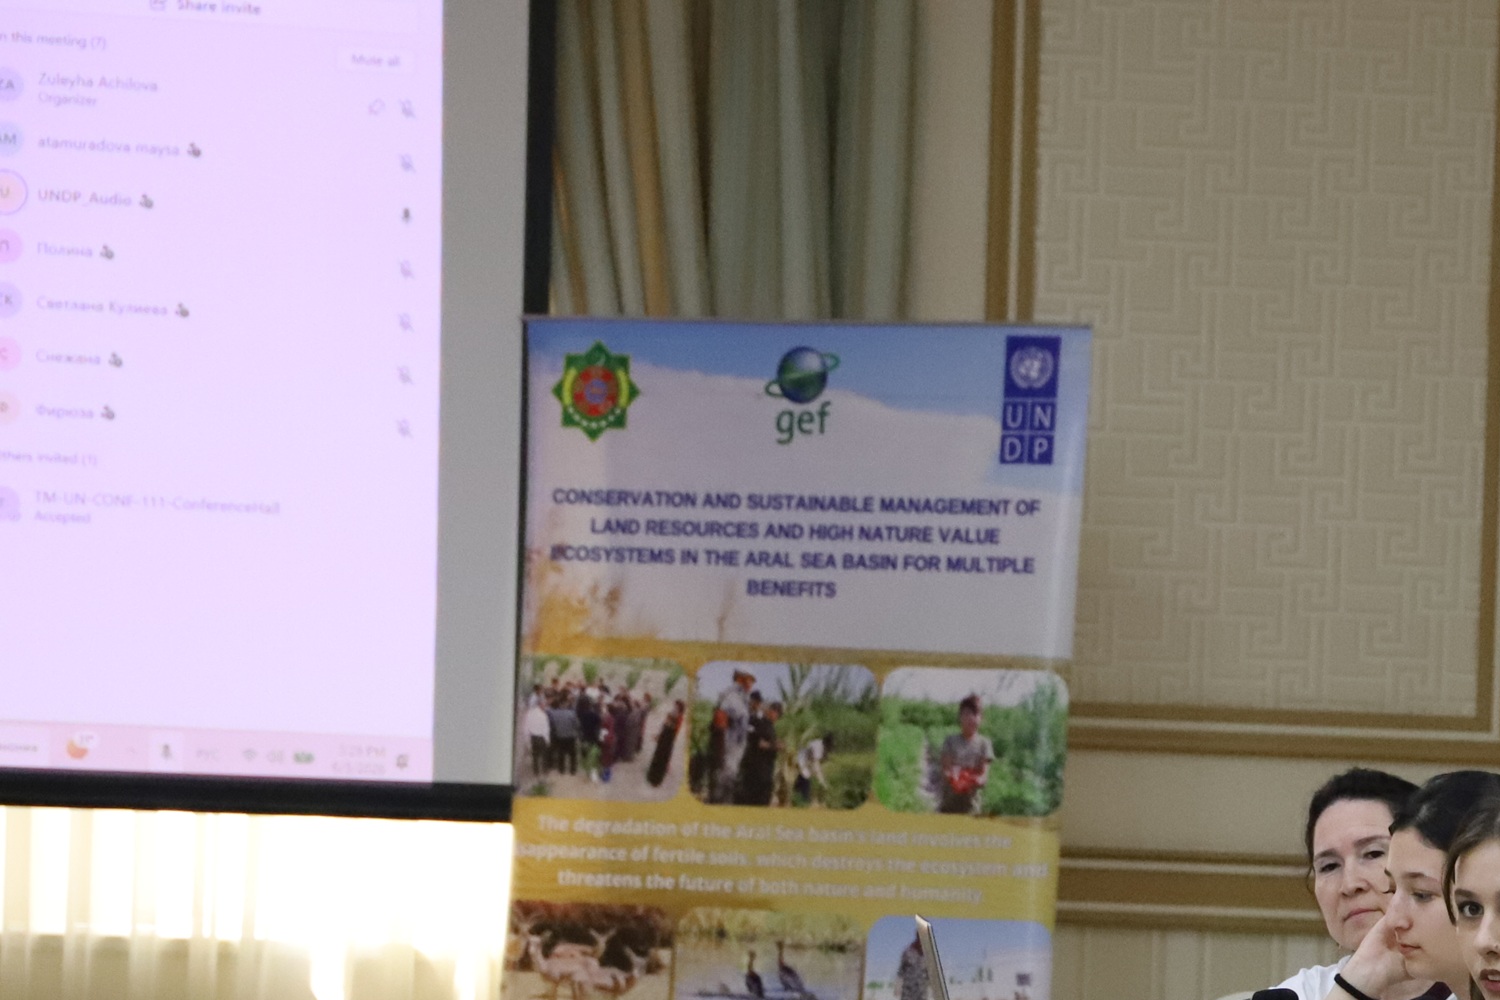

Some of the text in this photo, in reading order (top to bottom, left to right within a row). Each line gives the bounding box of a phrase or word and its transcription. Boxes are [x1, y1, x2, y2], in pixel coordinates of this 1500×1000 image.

[11, 31, 33, 44] this
[36, 33, 87, 49] meeting
[774, 401, 832, 446] gef
[552, 487, 1042, 516] CONSERVATION AND SUSTAINABLE MANAGEMENT OF
[590, 517, 1001, 545] LAND RESOURCES AND HIGH NATURE VALUE
[679, 549, 698, 565] IN
[704, 549, 740, 567] THE
[744, 550, 795, 568] ARAL
[800, 552, 837, 570] SEA
[842, 553, 898, 571] BASIN
[902, 555, 942, 572] FOR
[945, 556, 1036, 574] MULTIPLE
[746, 579, 837, 598] BENEFITS
[538, 814, 569, 832] The
[573, 818, 677, 838] degradation
[680, 822, 700, 837] of
[702, 822, 731, 839] the
[735, 823, 771, 841] Aral
[775, 825, 804, 842] Sea
[984, 833, 1012, 849] the
[631, 844, 649, 862] of
[653, 844, 705, 864] fertile
[756, 852, 807, 868] which
[811, 854, 884, 874] destroys
[887, 857, 916, 872] the
[920, 860, 1008, 878] ecosystem
[1012, 862, 1048, 879] and
[557, 869, 983, 906] threatens the future of both nature and humanity
